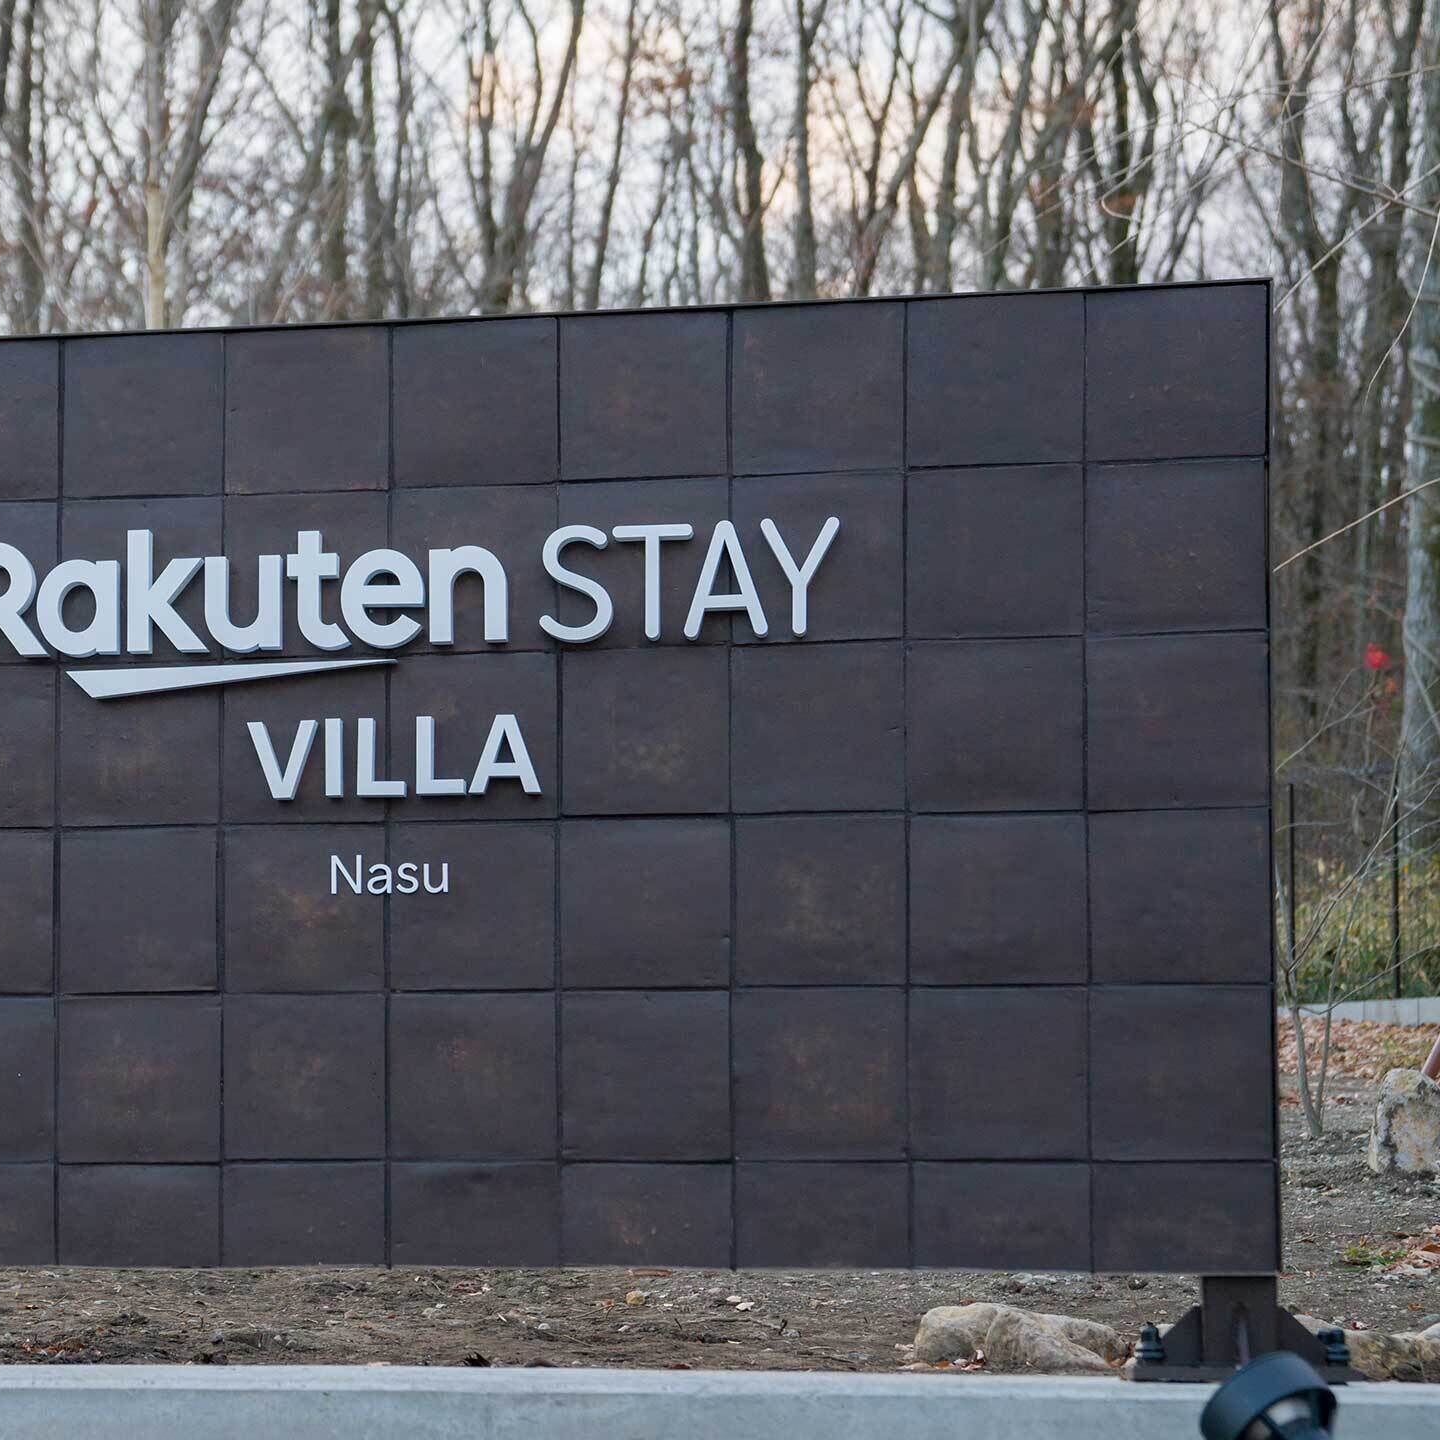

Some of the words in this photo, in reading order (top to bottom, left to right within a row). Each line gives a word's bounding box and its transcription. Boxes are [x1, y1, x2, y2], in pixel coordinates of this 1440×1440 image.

[538, 516, 841, 642] STAY
[246, 714, 543, 801] VILLA
[329, 854, 450, 896] Nasu
